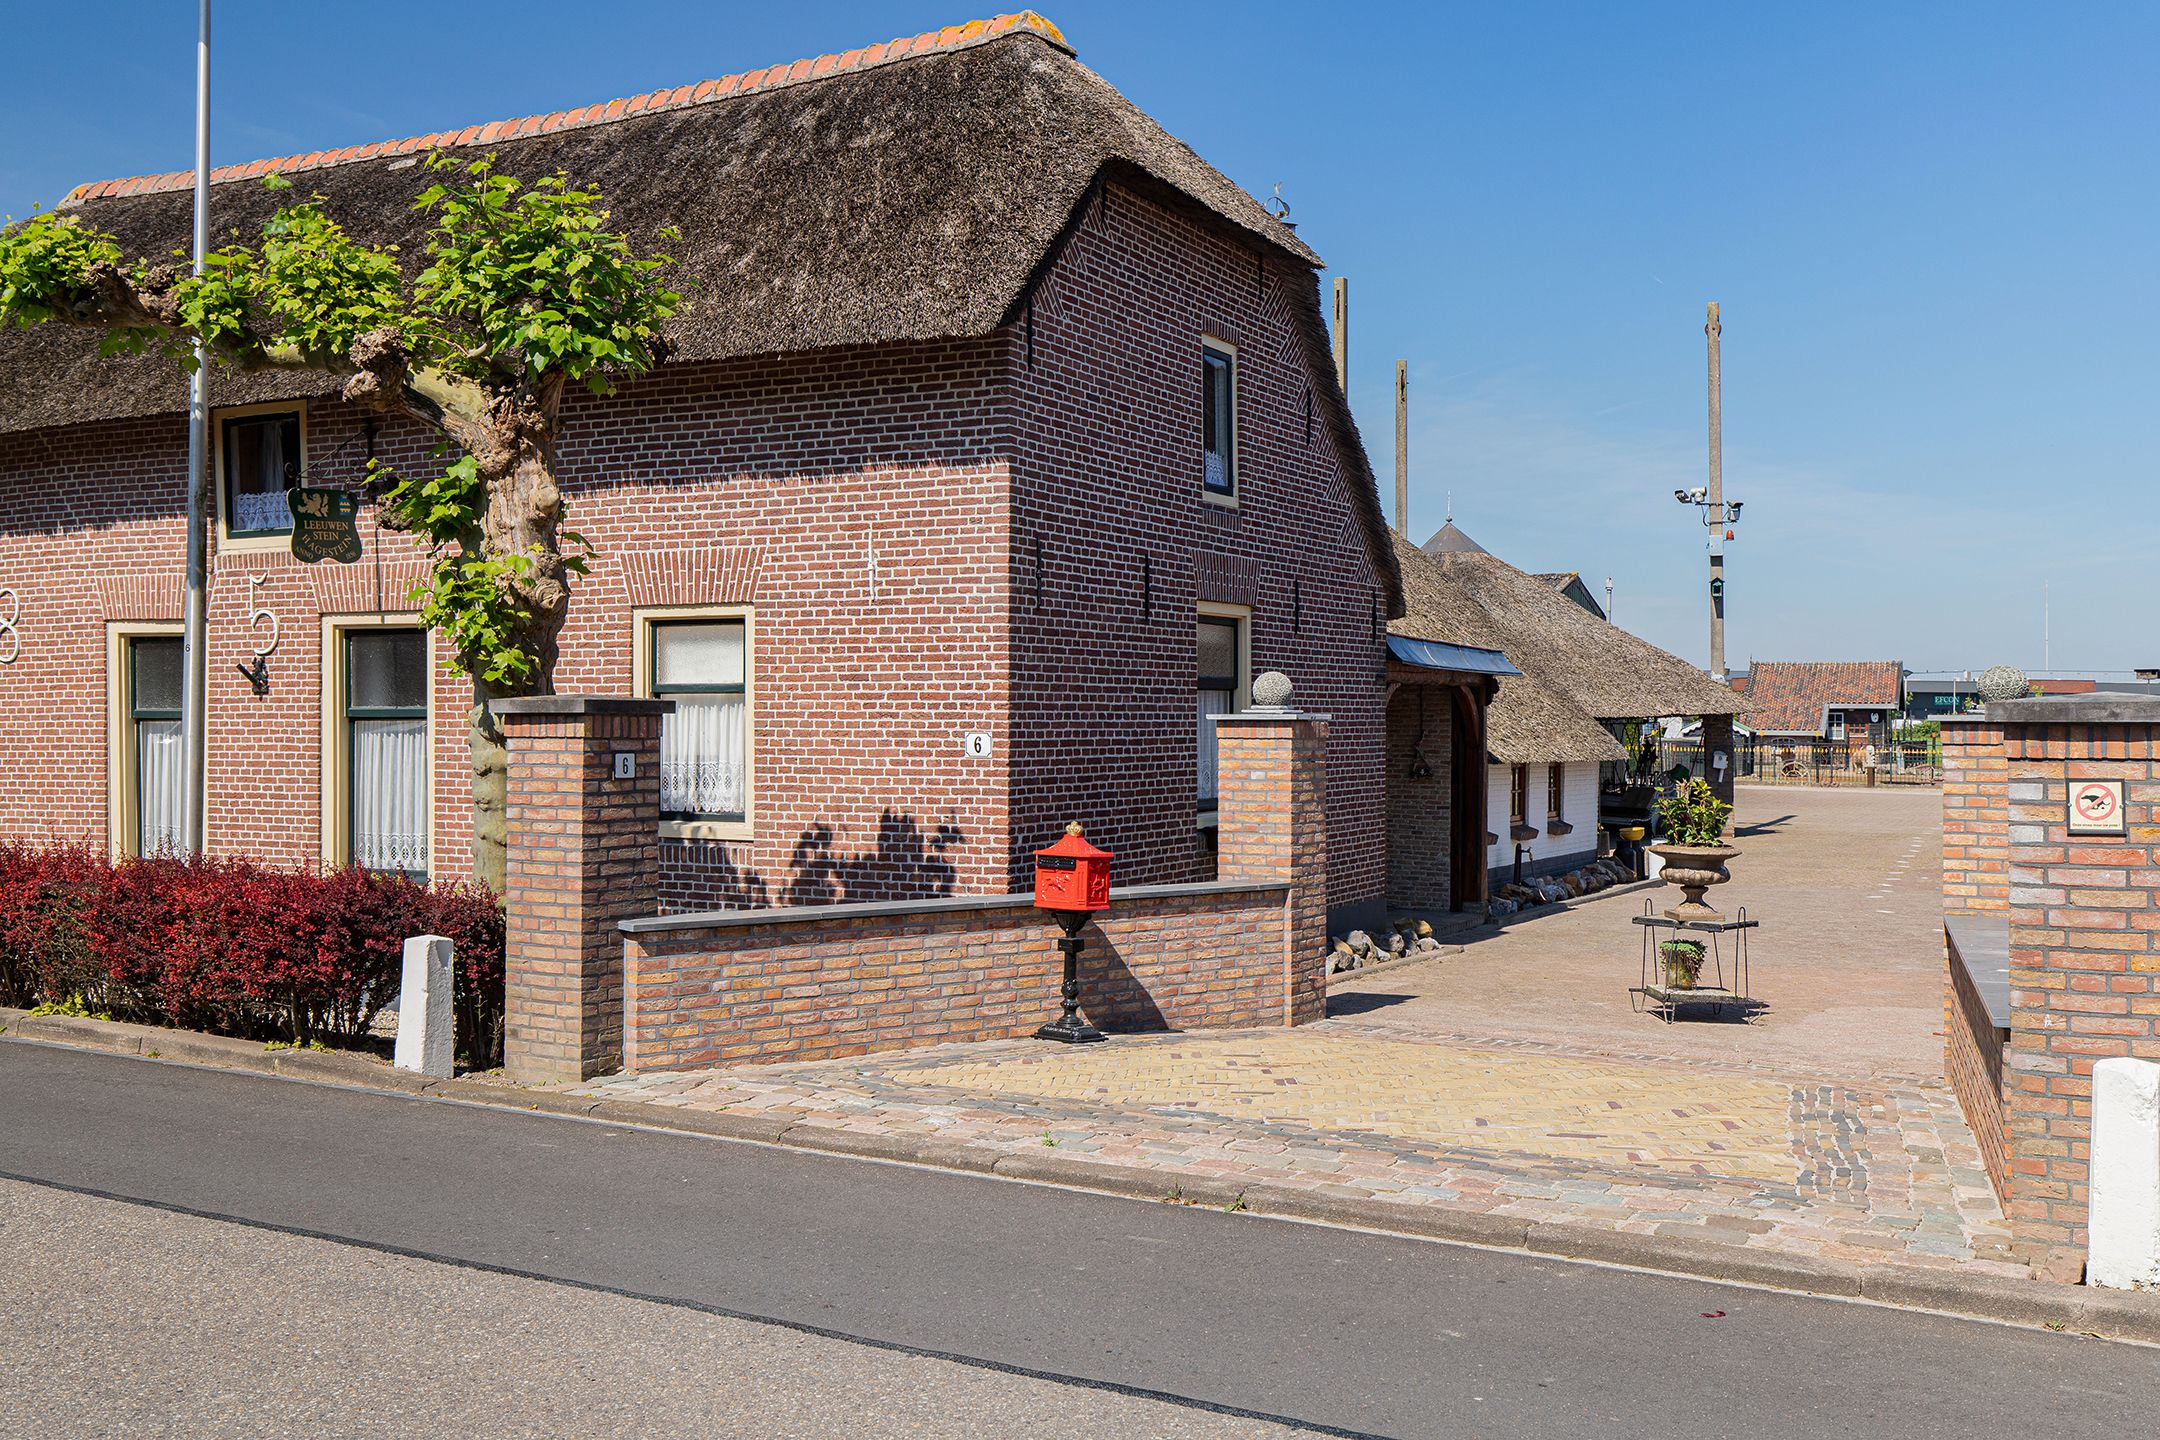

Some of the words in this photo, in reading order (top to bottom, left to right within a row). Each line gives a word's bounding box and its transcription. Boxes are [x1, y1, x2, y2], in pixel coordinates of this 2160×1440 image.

[304, 520, 349, 530] LEEUWEN
[302, 534, 352, 557] HAGESTEIN
[313, 531, 339, 541] STEIN
[974, 735, 982, 754] 6
[622, 756, 629, 775] 6
